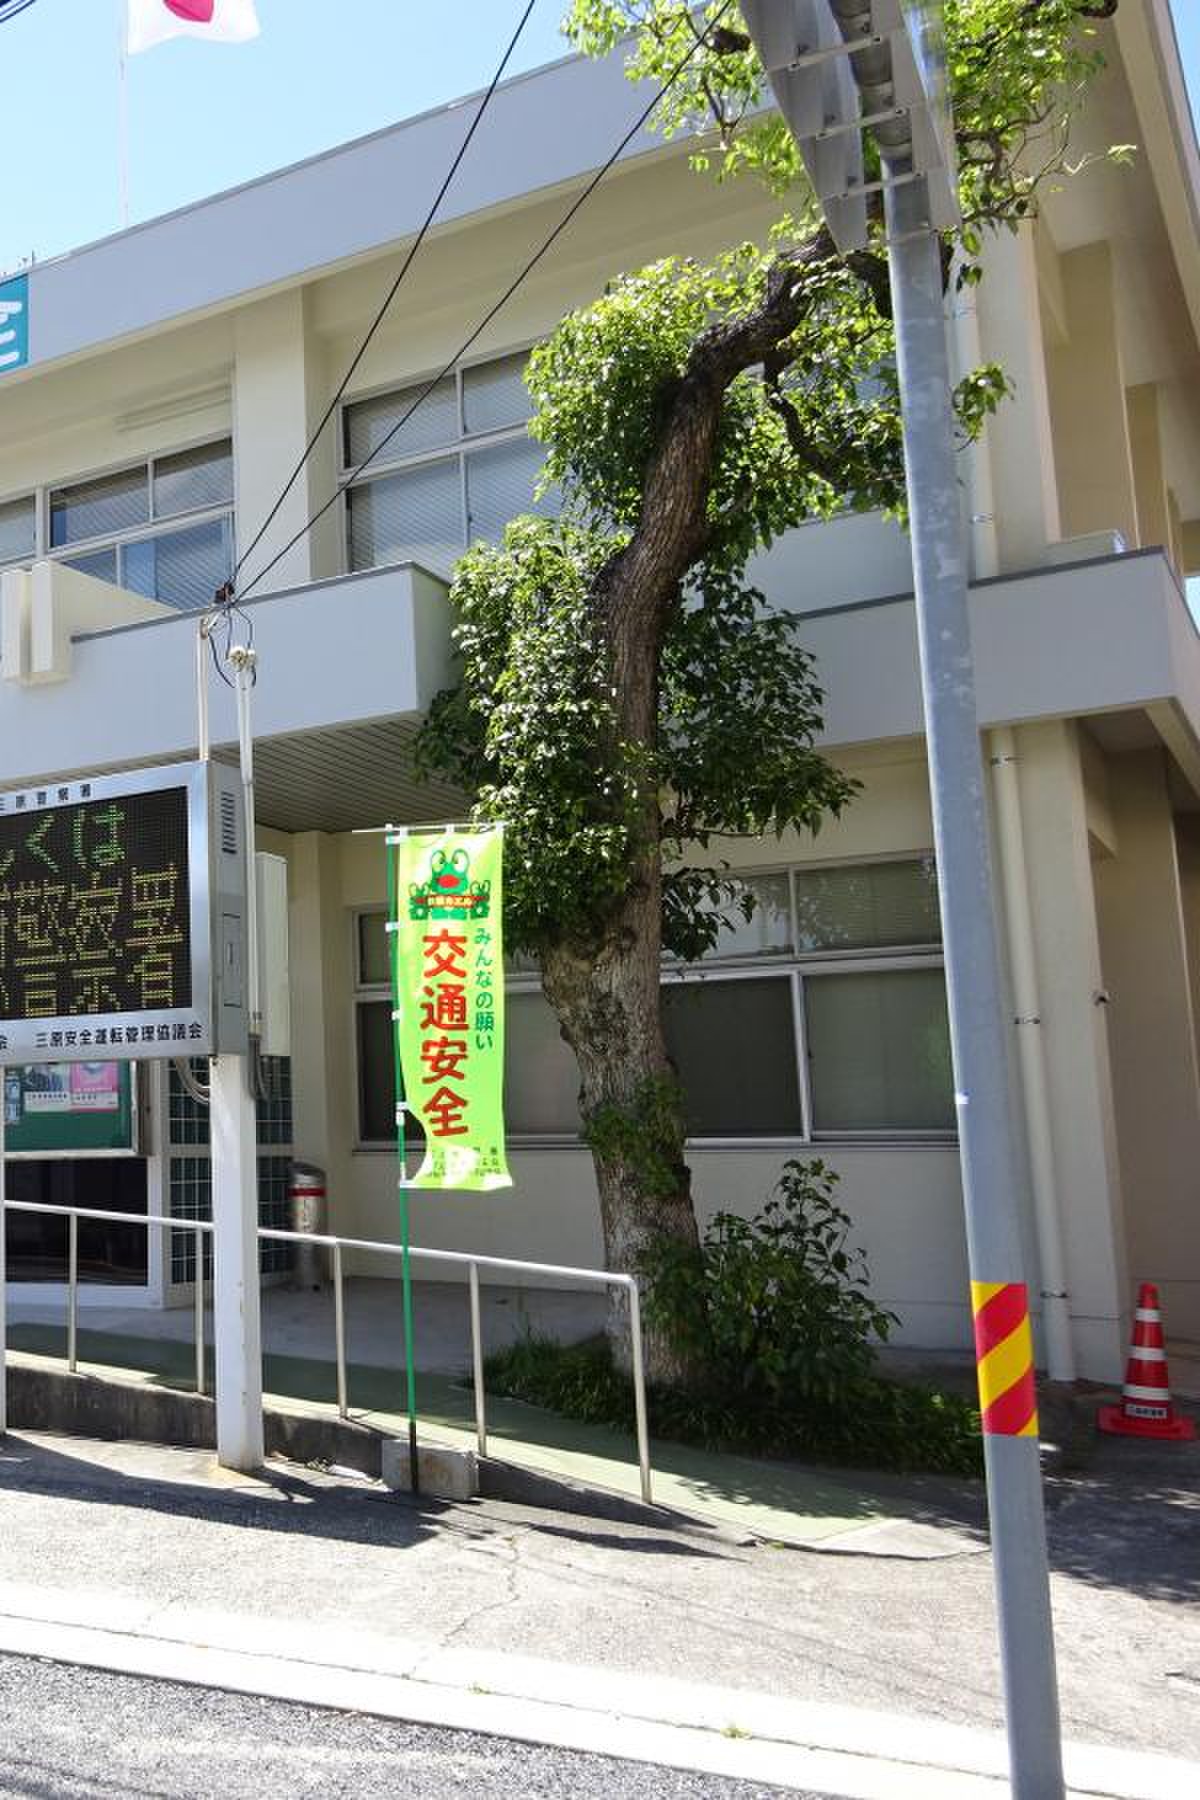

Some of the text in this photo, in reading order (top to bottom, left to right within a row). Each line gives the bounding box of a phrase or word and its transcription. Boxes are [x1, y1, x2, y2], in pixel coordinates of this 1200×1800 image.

[35, 1023, 203, 1048] 三原安全運転管理協議会
[420, 929, 469, 1138] 交通安全
[474, 927, 495, 1050] みんなの願い
